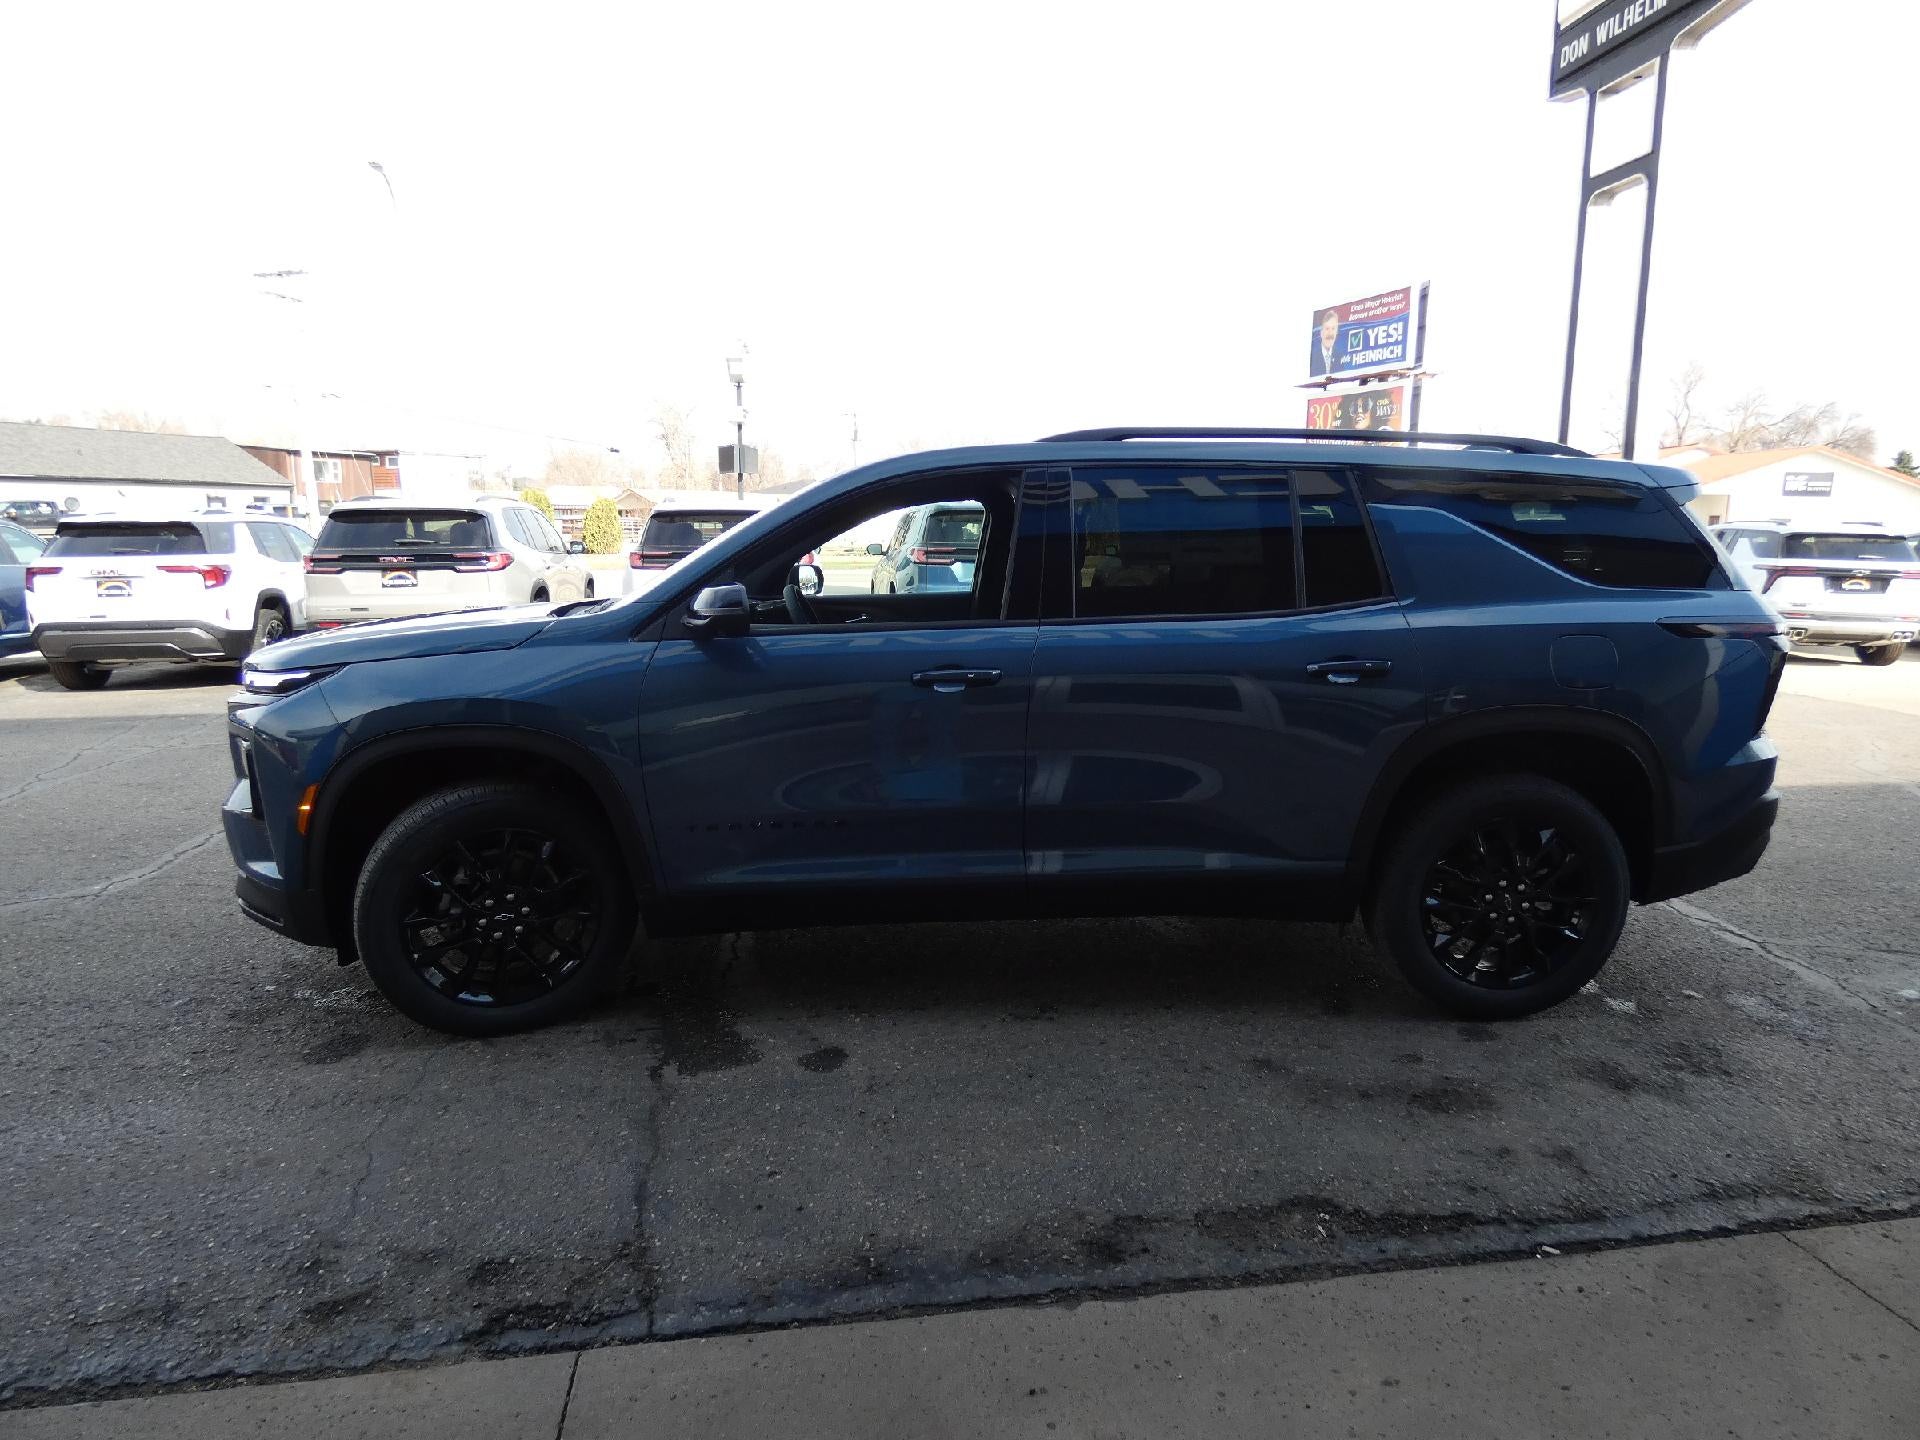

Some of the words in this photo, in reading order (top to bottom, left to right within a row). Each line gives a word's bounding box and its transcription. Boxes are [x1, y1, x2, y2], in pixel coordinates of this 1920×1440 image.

[1560, 32, 1590, 68] DON
[1367, 321, 1404, 347] YES!
[1352, 344, 1403, 366] HEINRICH
